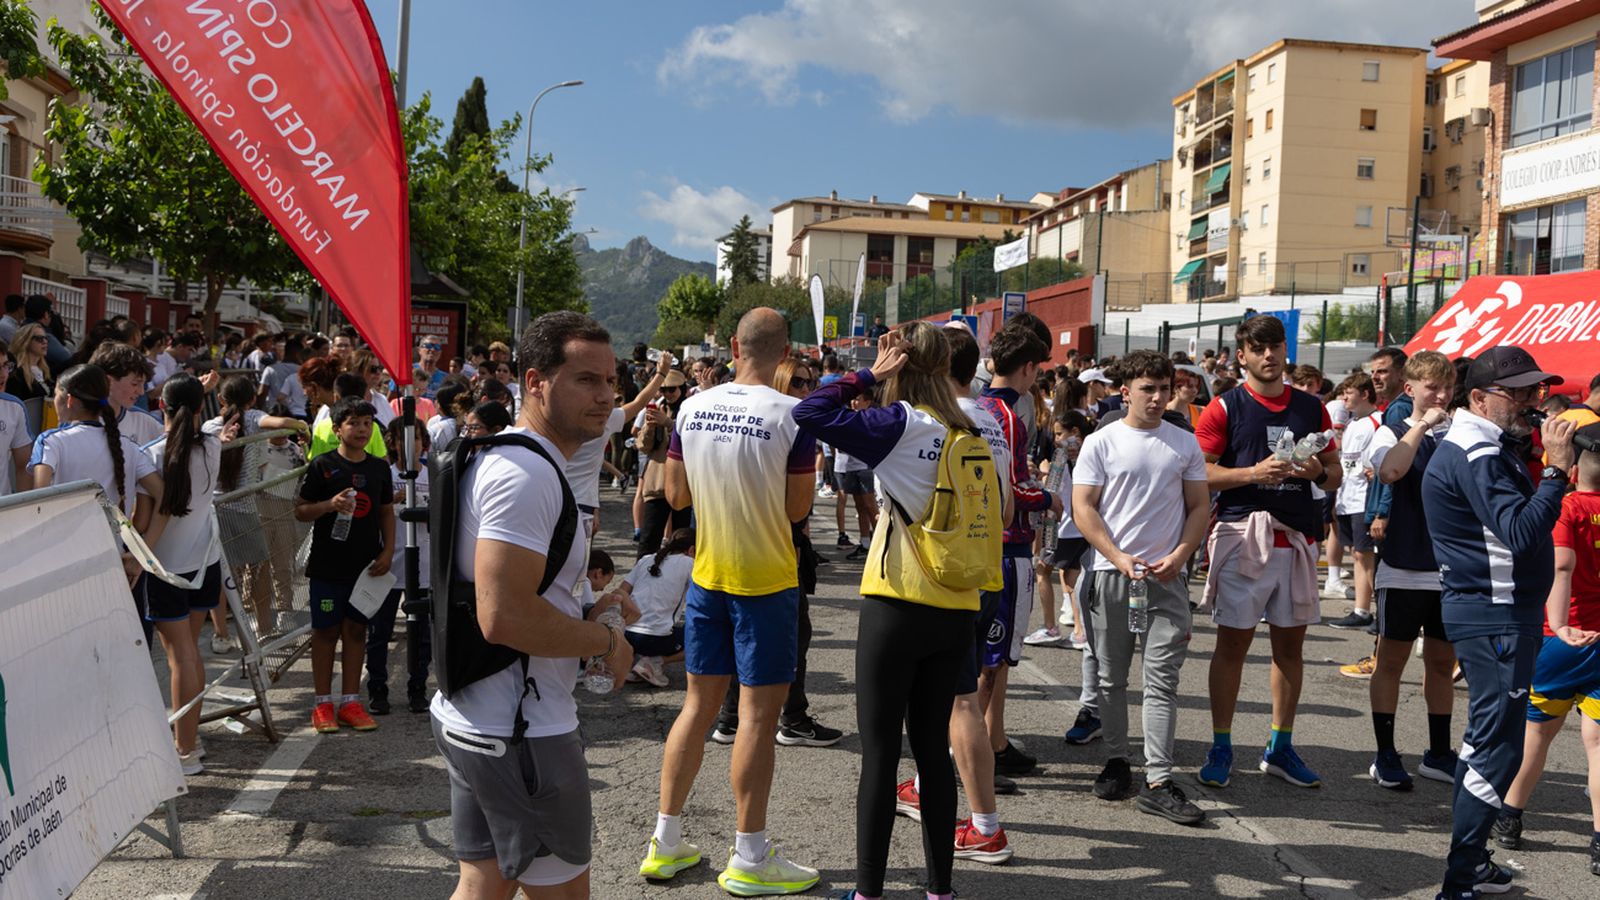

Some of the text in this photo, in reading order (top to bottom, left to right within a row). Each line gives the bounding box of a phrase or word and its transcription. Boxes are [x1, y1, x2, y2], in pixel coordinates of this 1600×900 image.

[1504, 164, 1537, 190] COLEGIO
[713, 403, 748, 413] COLEGIO
[693, 410, 729, 422] SANTA
[747, 416, 764, 426] DE
[686, 421, 771, 440] LOS APÓSTOLES
[713, 434, 732, 443] JAÉN
[10, 780, 55, 831] Municipal
[54, 774, 68, 795] de
[27, 827, 42, 850] de
[41, 808, 63, 839] Jaén
